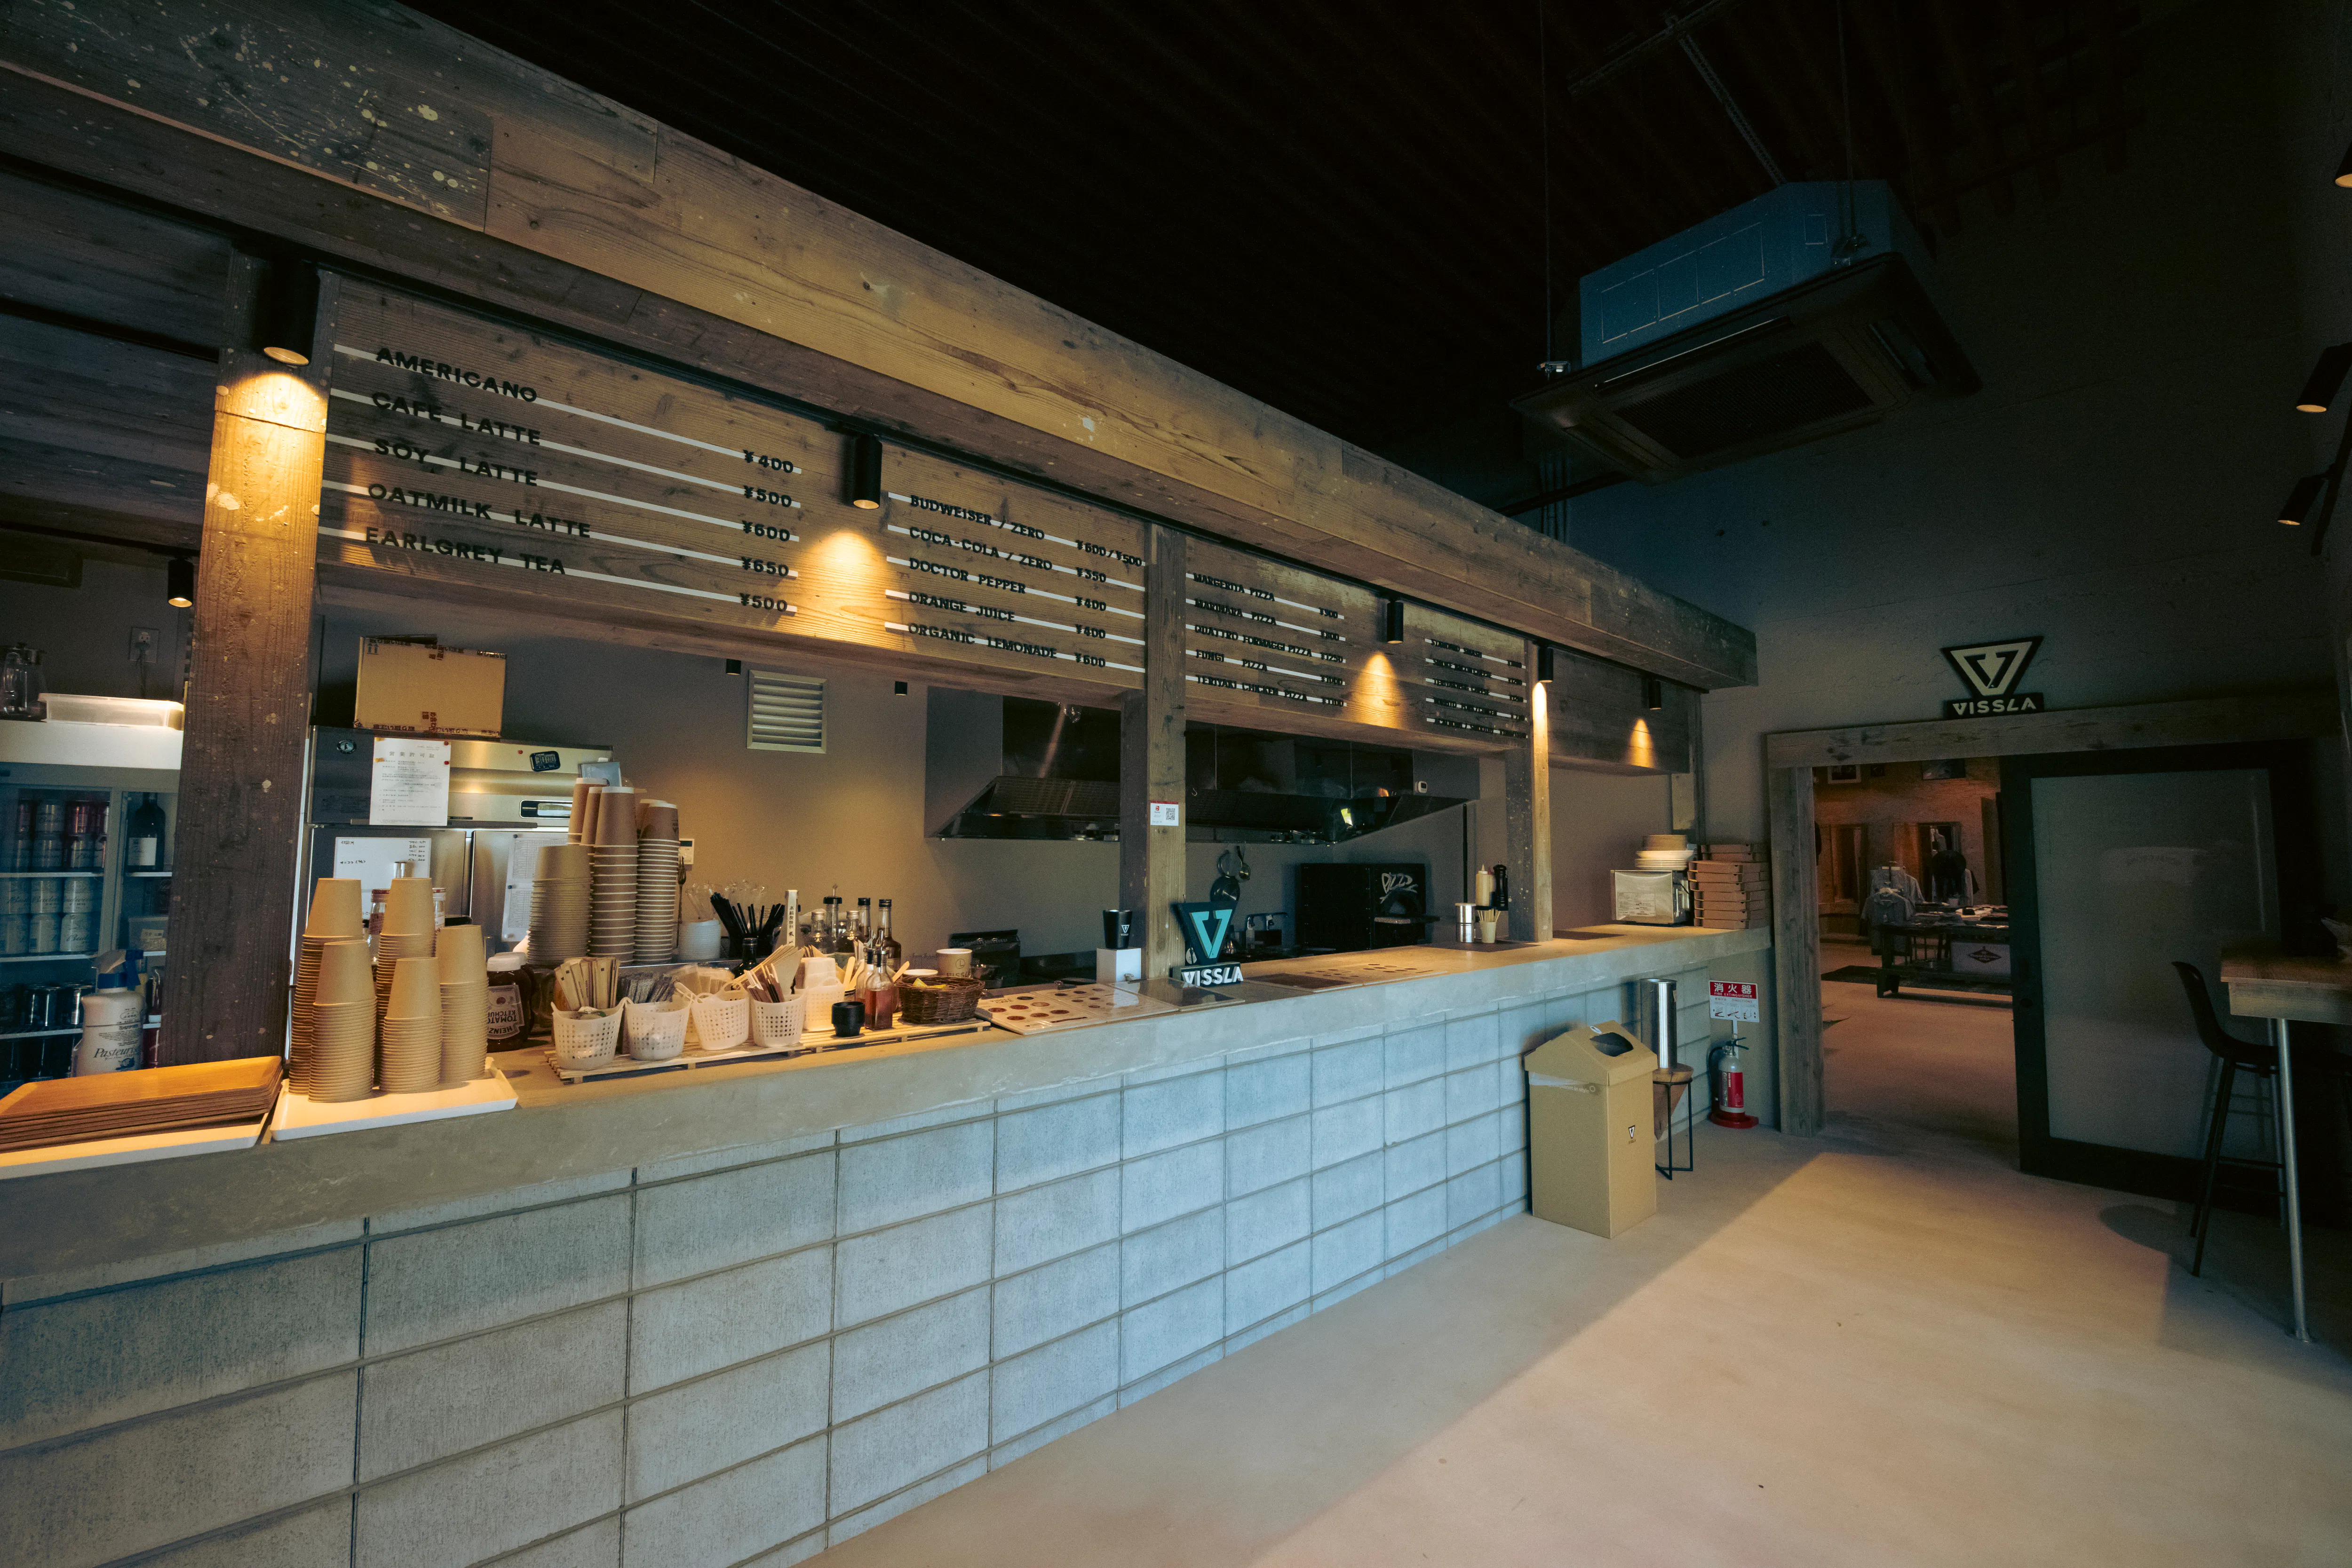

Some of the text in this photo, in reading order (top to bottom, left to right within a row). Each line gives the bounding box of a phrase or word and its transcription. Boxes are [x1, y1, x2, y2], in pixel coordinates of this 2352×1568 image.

[376, 348, 794, 474] AMERICANO ¥400
[372, 392, 792, 508] CAFE LATTE ¥500
[375, 438, 790, 542] SOY LATTE ¥600
[367, 483, 789, 578] OATMILK LATTE ¥650
[910, 494, 992, 526] BUDWEISER
[1011, 522, 1045, 540] ZERO
[365, 526, 787, 613] EARLGREY TEA ¥500
[909, 526, 1000, 558] COCA-COLA
[1019, 553, 1053, 571] ZERO
[1075, 567, 1107, 583] ¥350
[909, 557, 1107, 612] DOCTOR PEPPER ¥400
[1249, 587, 1275, 602] PIZZA
[908, 591, 1106, 639] ORANGE JUICE ¥400
[1251, 612, 1277, 626] PIZZA
[908, 622, 1106, 668] ORGANIC LEMONADE ¥600
[1194, 624, 1239, 641] QUATTRO
[1288, 644, 1312, 657] PIZZA
[1196, 649, 1225, 662] FUNGI
[1242, 659, 1268, 672] PIZZA
[1195, 674, 1237, 690] TERIYAKI
[1241, 683, 1279, 696] CHICKEN
[1284, 690, 1308, 702] PIZZA
[1952, 697, 2037, 716] VISSLA
[1182, 966, 1244, 987] VISSLA
[1714, 982, 1752, 994] 消火器
[488, 1026, 513, 1035] HEINZ
